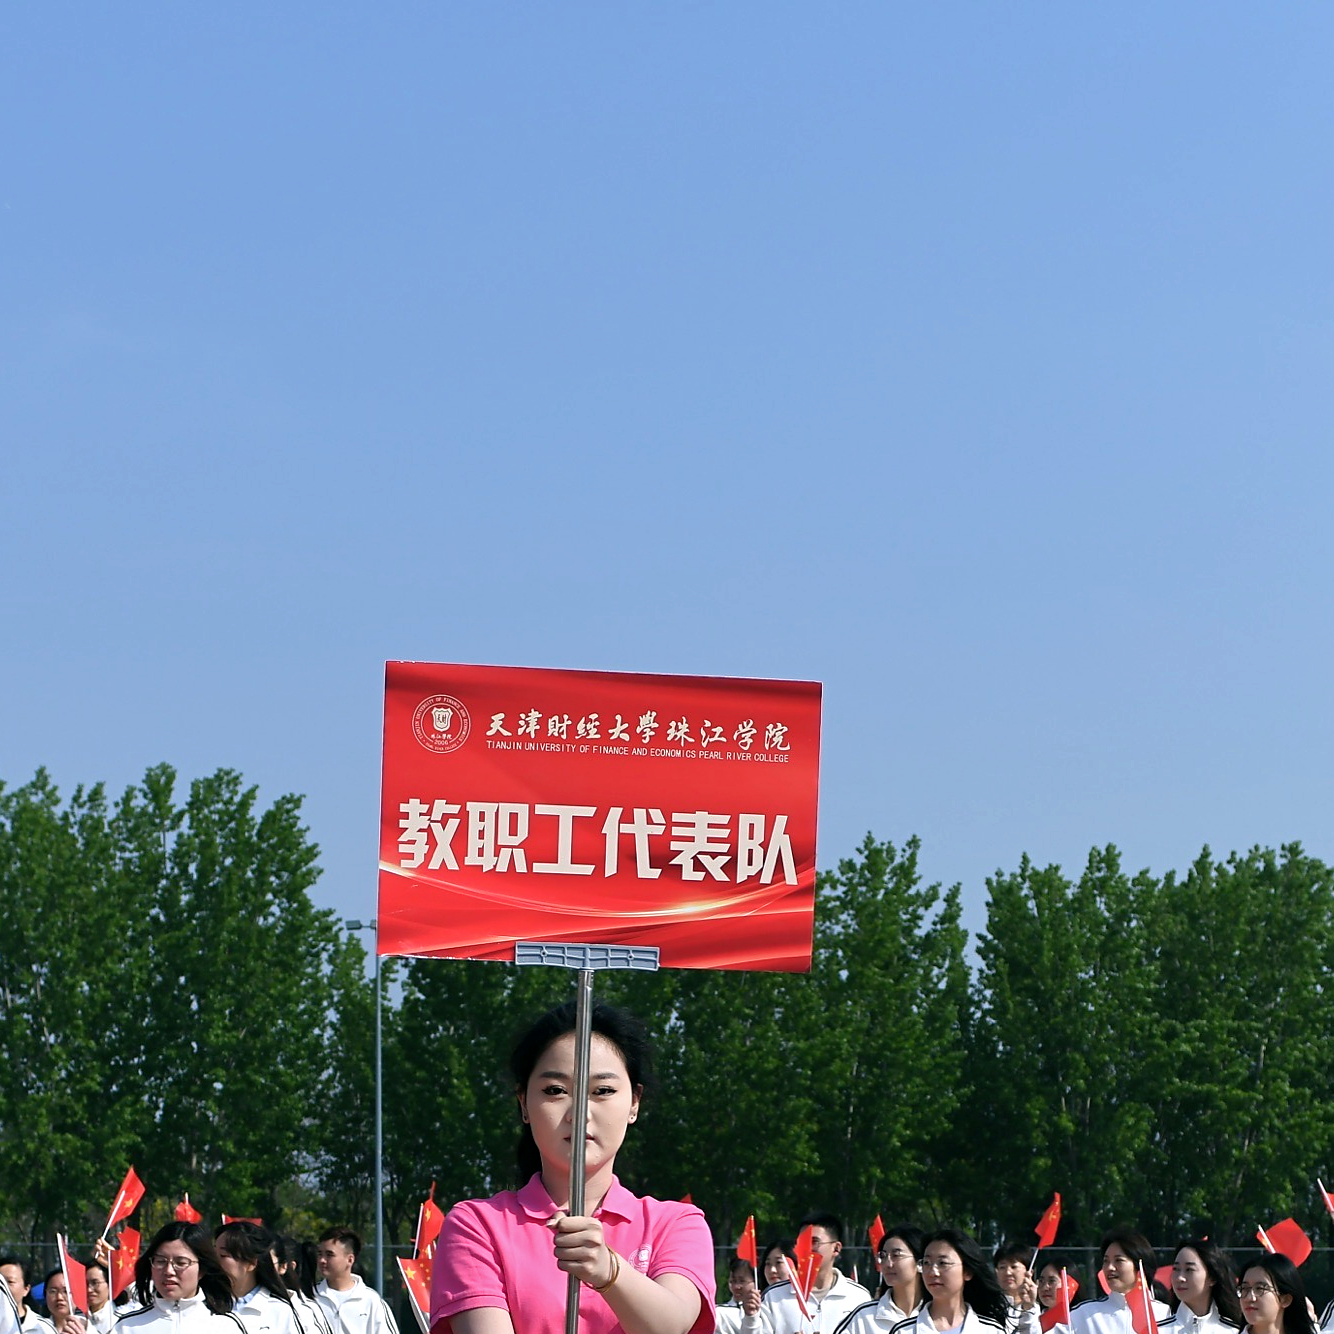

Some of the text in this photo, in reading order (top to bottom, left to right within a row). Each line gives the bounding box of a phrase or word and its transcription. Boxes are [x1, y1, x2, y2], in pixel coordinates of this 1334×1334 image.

[486, 740, 789, 763] TIANJIN UNIVERSITY OF FINANCE AND ECONOMICS PEARL RIVER COLLEGE
[397, 798, 798, 886] 教职工代表队
